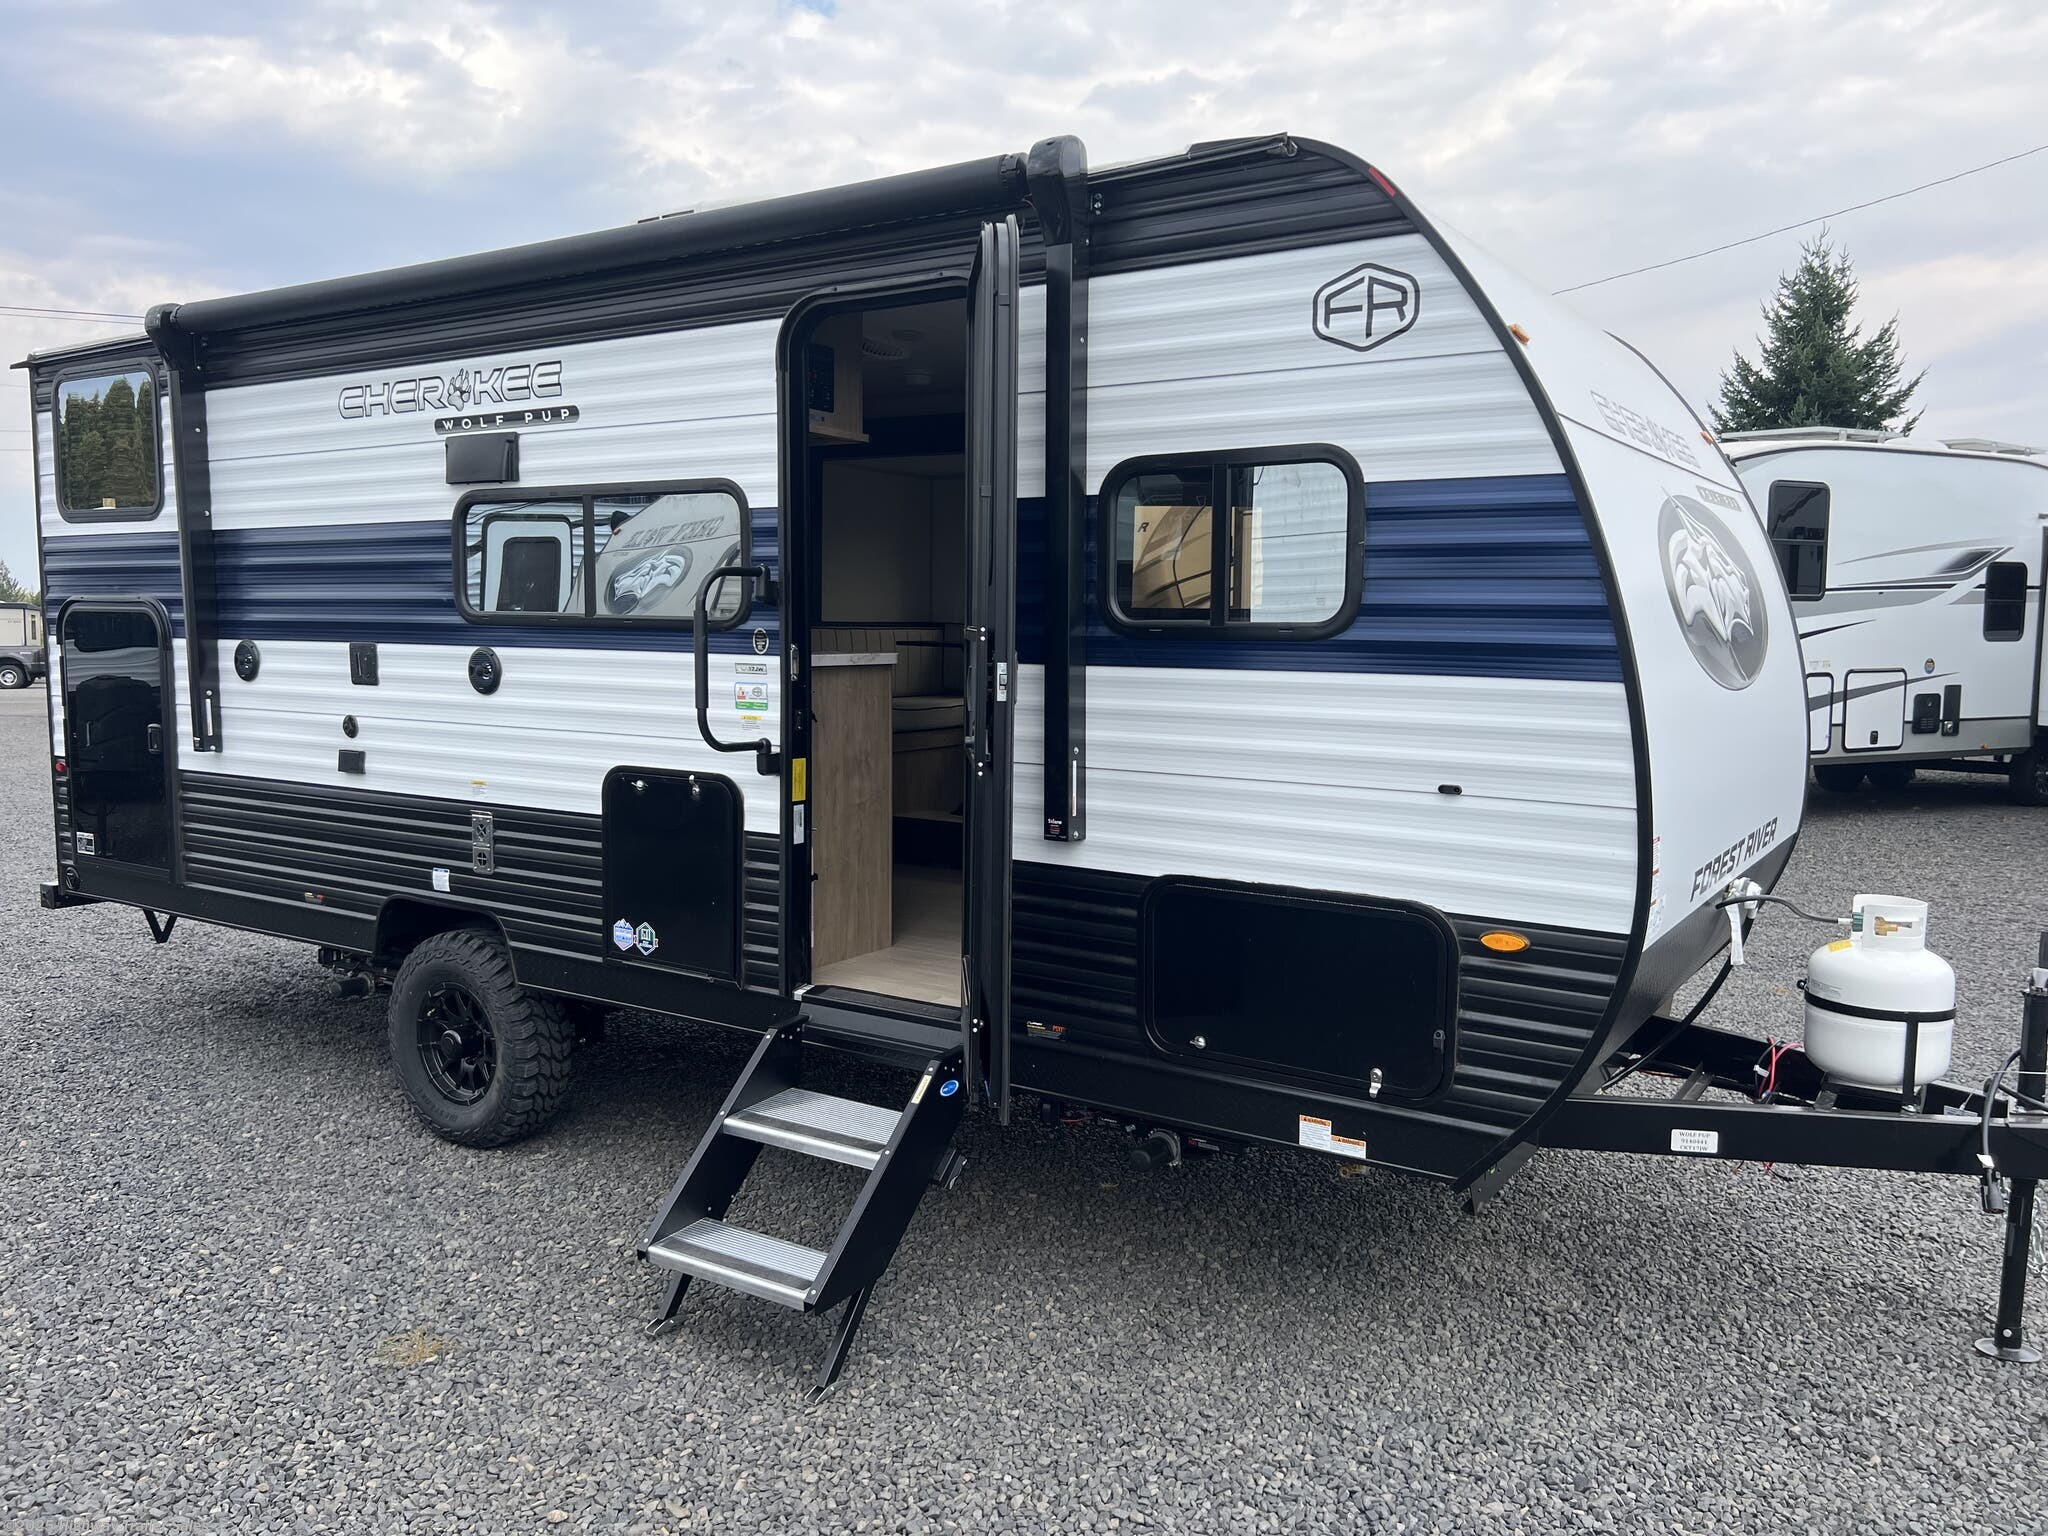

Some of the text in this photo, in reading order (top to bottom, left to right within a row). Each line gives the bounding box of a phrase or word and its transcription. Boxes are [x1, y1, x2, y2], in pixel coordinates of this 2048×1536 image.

[442, 409, 570, 431] WOLF PUP
[1690, 837, 1746, 903] FOREST
[1744, 816, 1778, 861] RIVER
